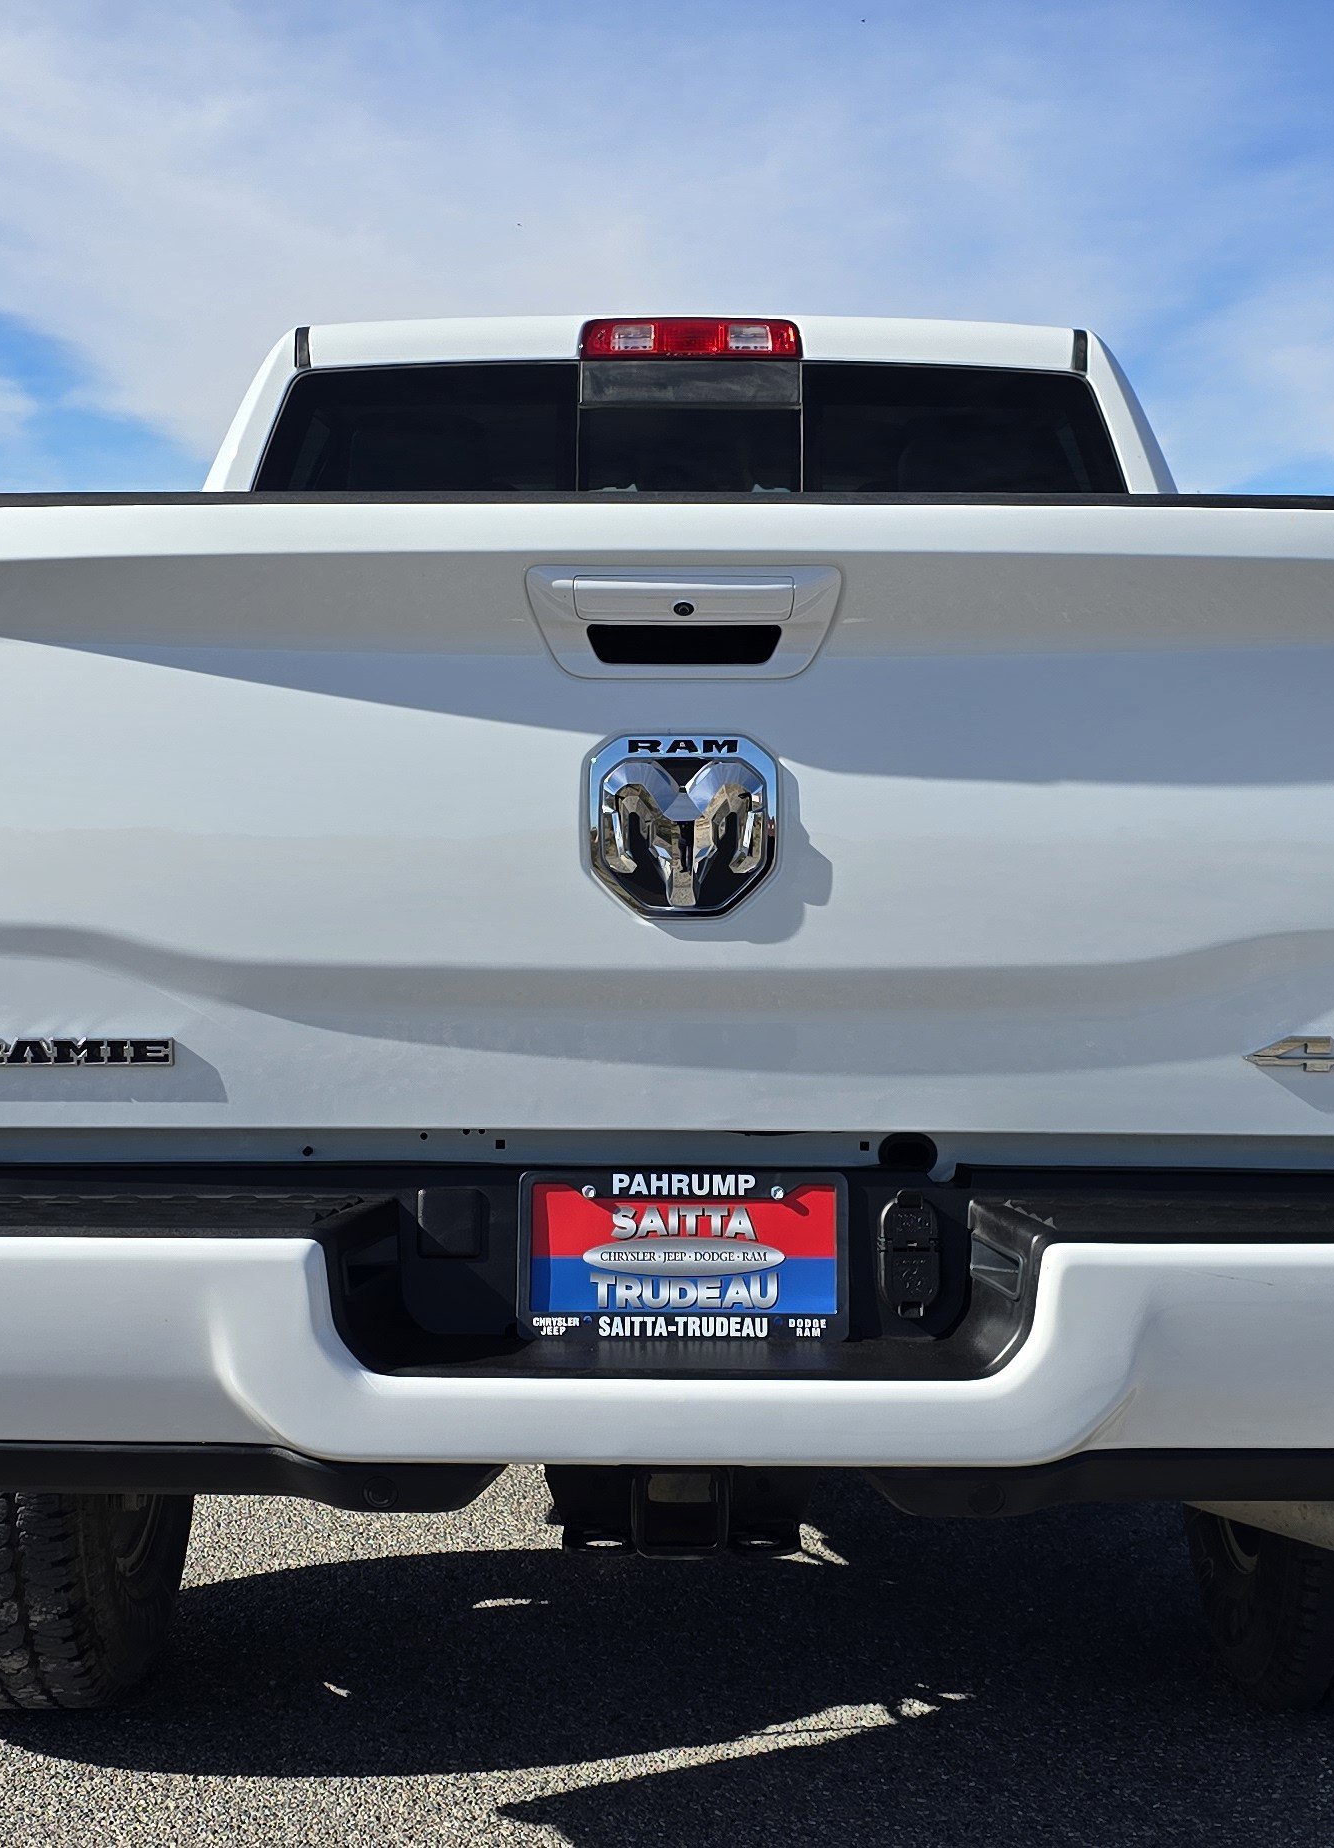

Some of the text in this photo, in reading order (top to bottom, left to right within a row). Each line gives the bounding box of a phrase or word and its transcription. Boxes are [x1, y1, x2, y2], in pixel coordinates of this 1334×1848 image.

[627, 739, 739, 754] RAM
[612, 1174, 756, 1197] PAHRUMP
[611, 1205, 757, 1240] SAITTA
[600, 1251, 768, 1263] CHRYSLER JEEP DODGE RAM
[590, 1272, 779, 1309] TRUDEAU
[532, 1316, 580, 1327] CHRYSLER
[598, 1316, 768, 1338] SAITTA-TRUDEAU
[788, 1318, 827, 1329] DODGE
[540, 1326, 567, 1336] JEEP
[795, 1328, 821, 1338] RAM
